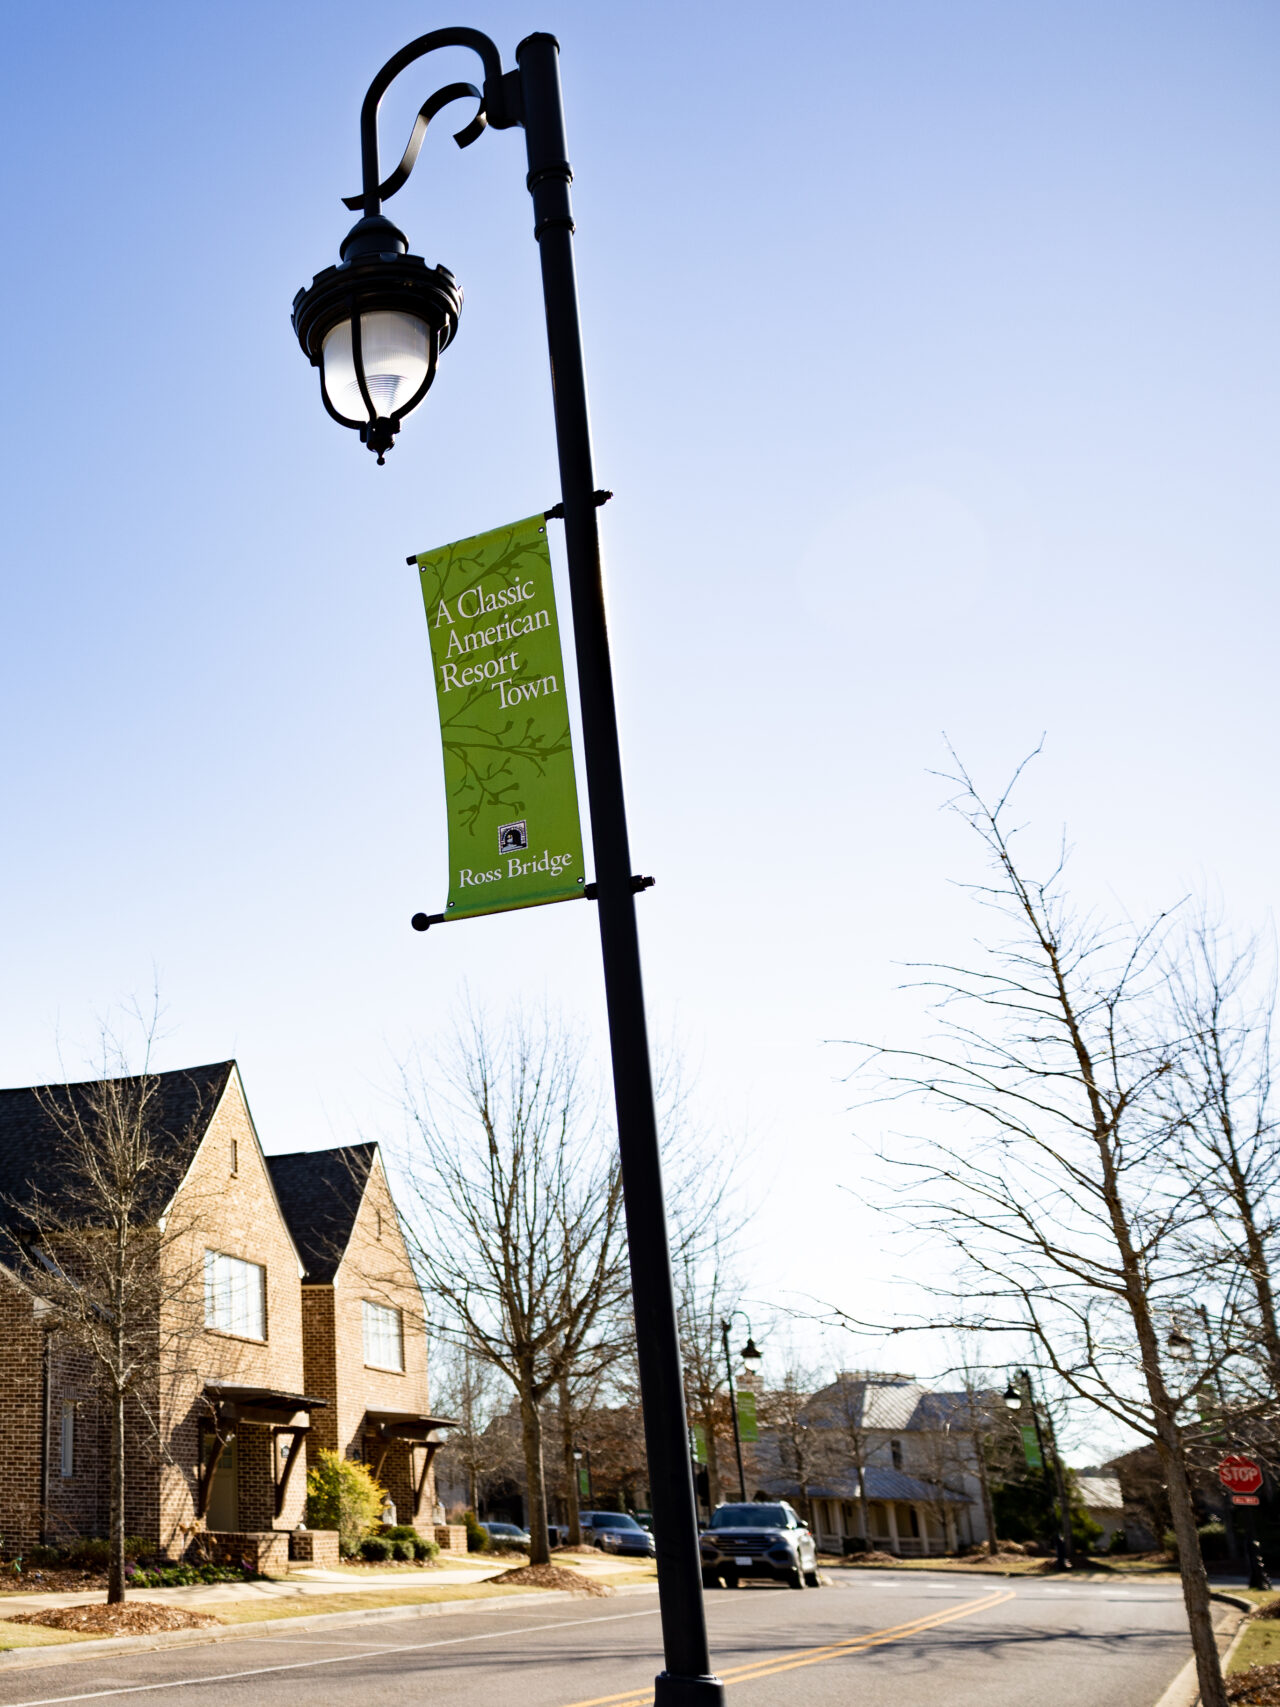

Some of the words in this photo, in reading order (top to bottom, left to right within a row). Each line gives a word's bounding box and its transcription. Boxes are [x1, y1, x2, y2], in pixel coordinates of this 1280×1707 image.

[433, 598, 456, 629] A
[457, 576, 536, 619] Classic
[445, 609, 551, 659] American
[440, 651, 520, 693] Resort
[491, 675, 559, 710] Town
[459, 868, 502, 888] Ross
[507, 850, 572, 877] Bridge
[1222, 1466, 1258, 1482] STOP
